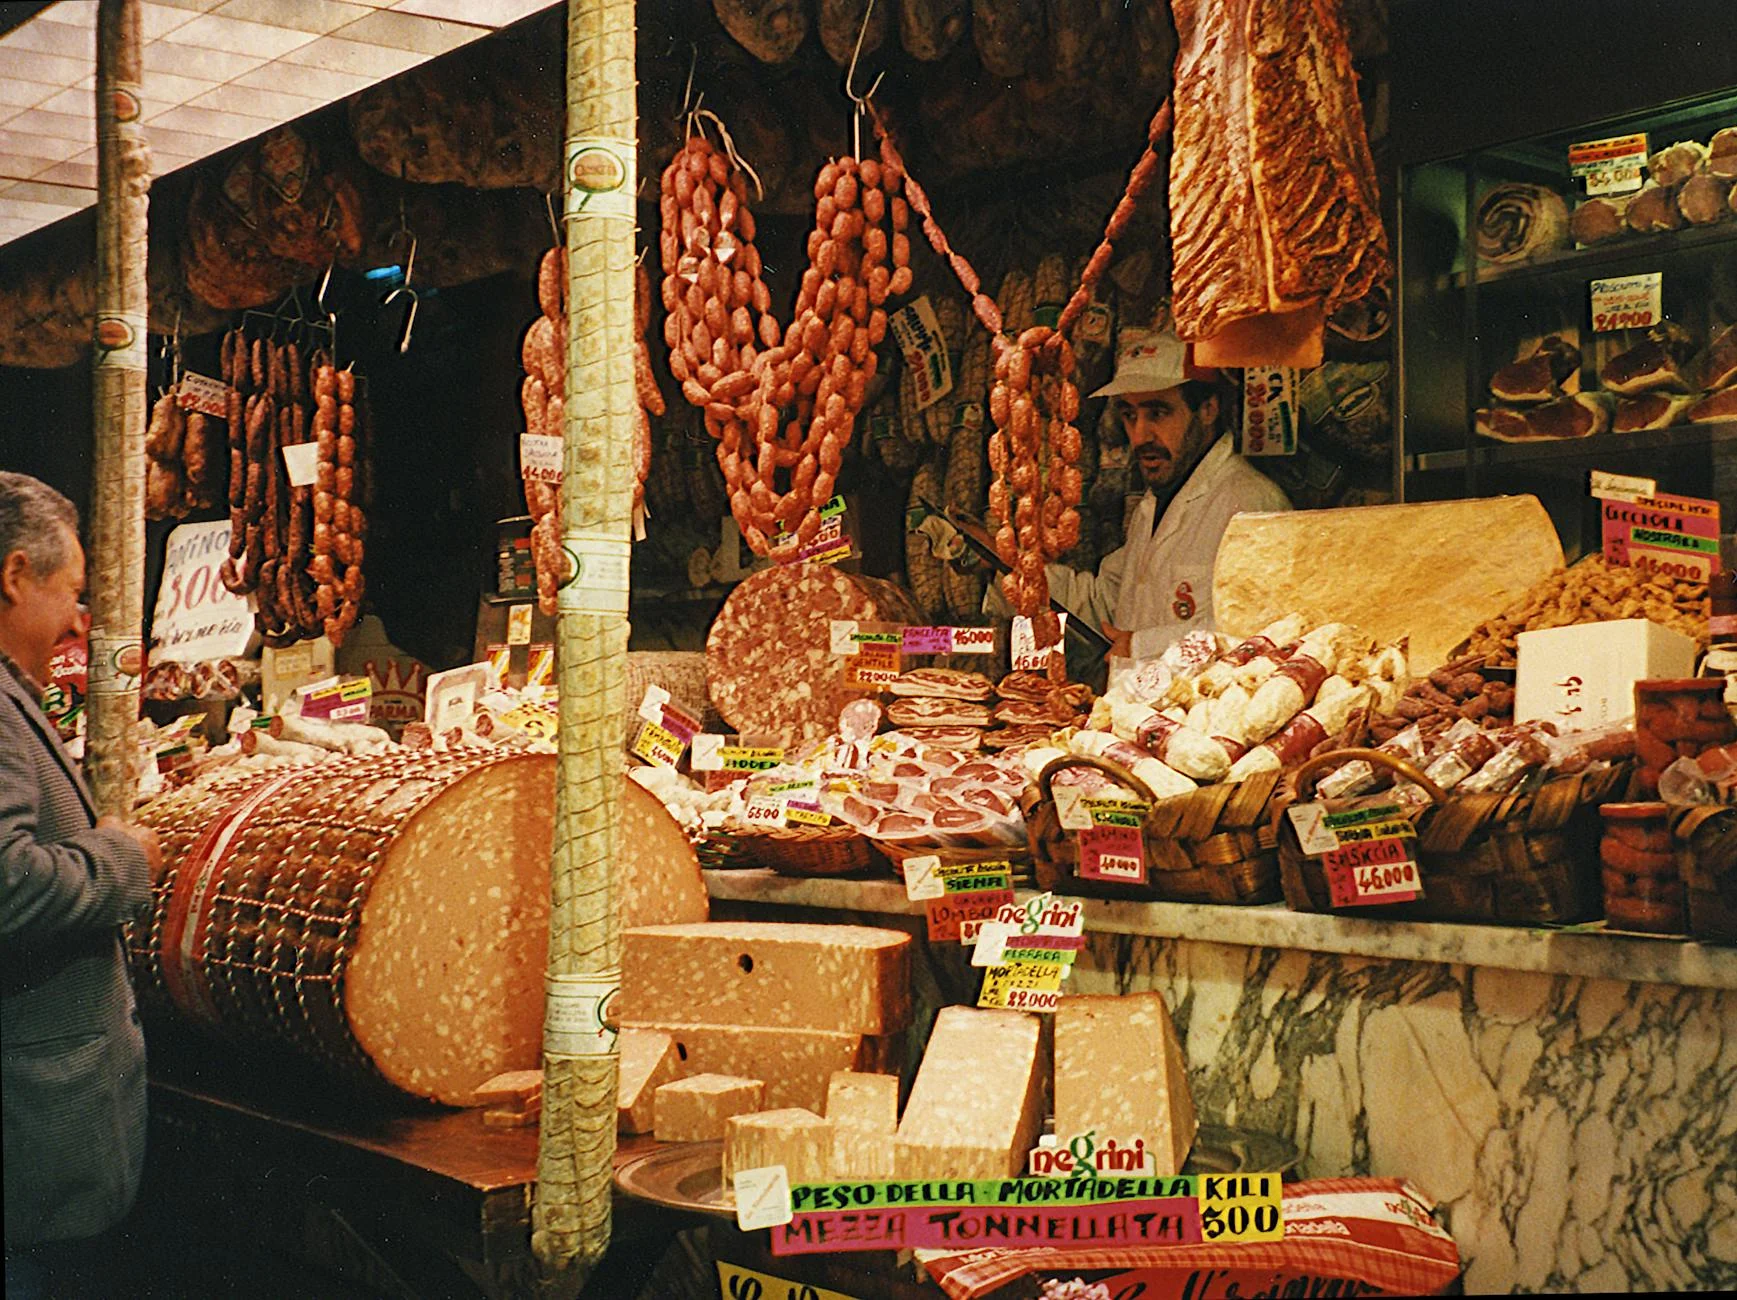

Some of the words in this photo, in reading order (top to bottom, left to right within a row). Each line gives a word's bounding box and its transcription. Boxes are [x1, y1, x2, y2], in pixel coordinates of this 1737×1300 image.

[946, 876, 1004, 891] SIENA
[999, 897, 1080, 934] negrini
[1034, 1130, 1144, 1177] negrini
[791, 1183, 876, 1210] PESO
[885, 1181, 975, 1204] DELLA
[998, 1176, 1191, 1205] MORTADELLA
[1205, 1176, 1270, 1201] KILI
[784, 1211, 906, 1245] MEZZA
[929, 1211, 1184, 1242] TONNELLATA
[1201, 1203, 1280, 1240] 500
